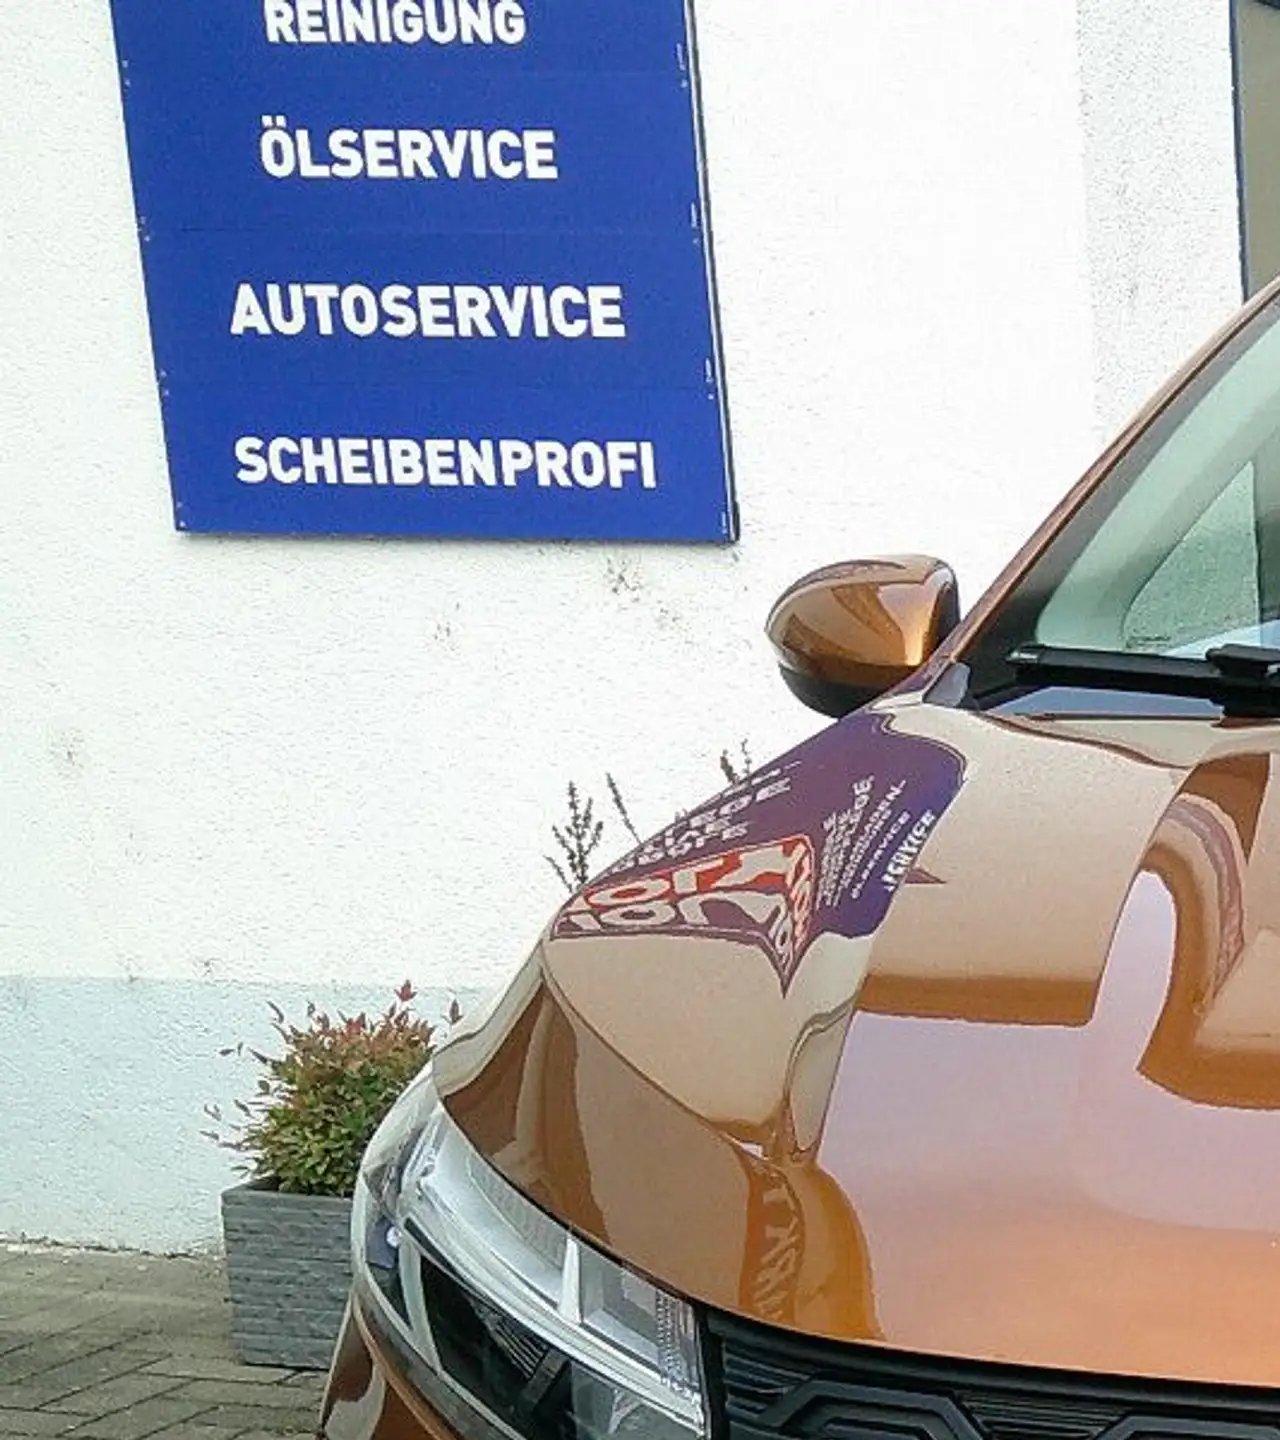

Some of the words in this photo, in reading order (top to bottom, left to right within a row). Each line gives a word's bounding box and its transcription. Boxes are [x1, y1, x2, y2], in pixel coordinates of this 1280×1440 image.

[264, 0, 526, 44] REINIGUNG
[260, 115, 558, 179] ÖLSERVICE
[230, 283, 626, 338] AUTOSERVICE
[235, 436, 657, 489] SCHEIBENPROFI
